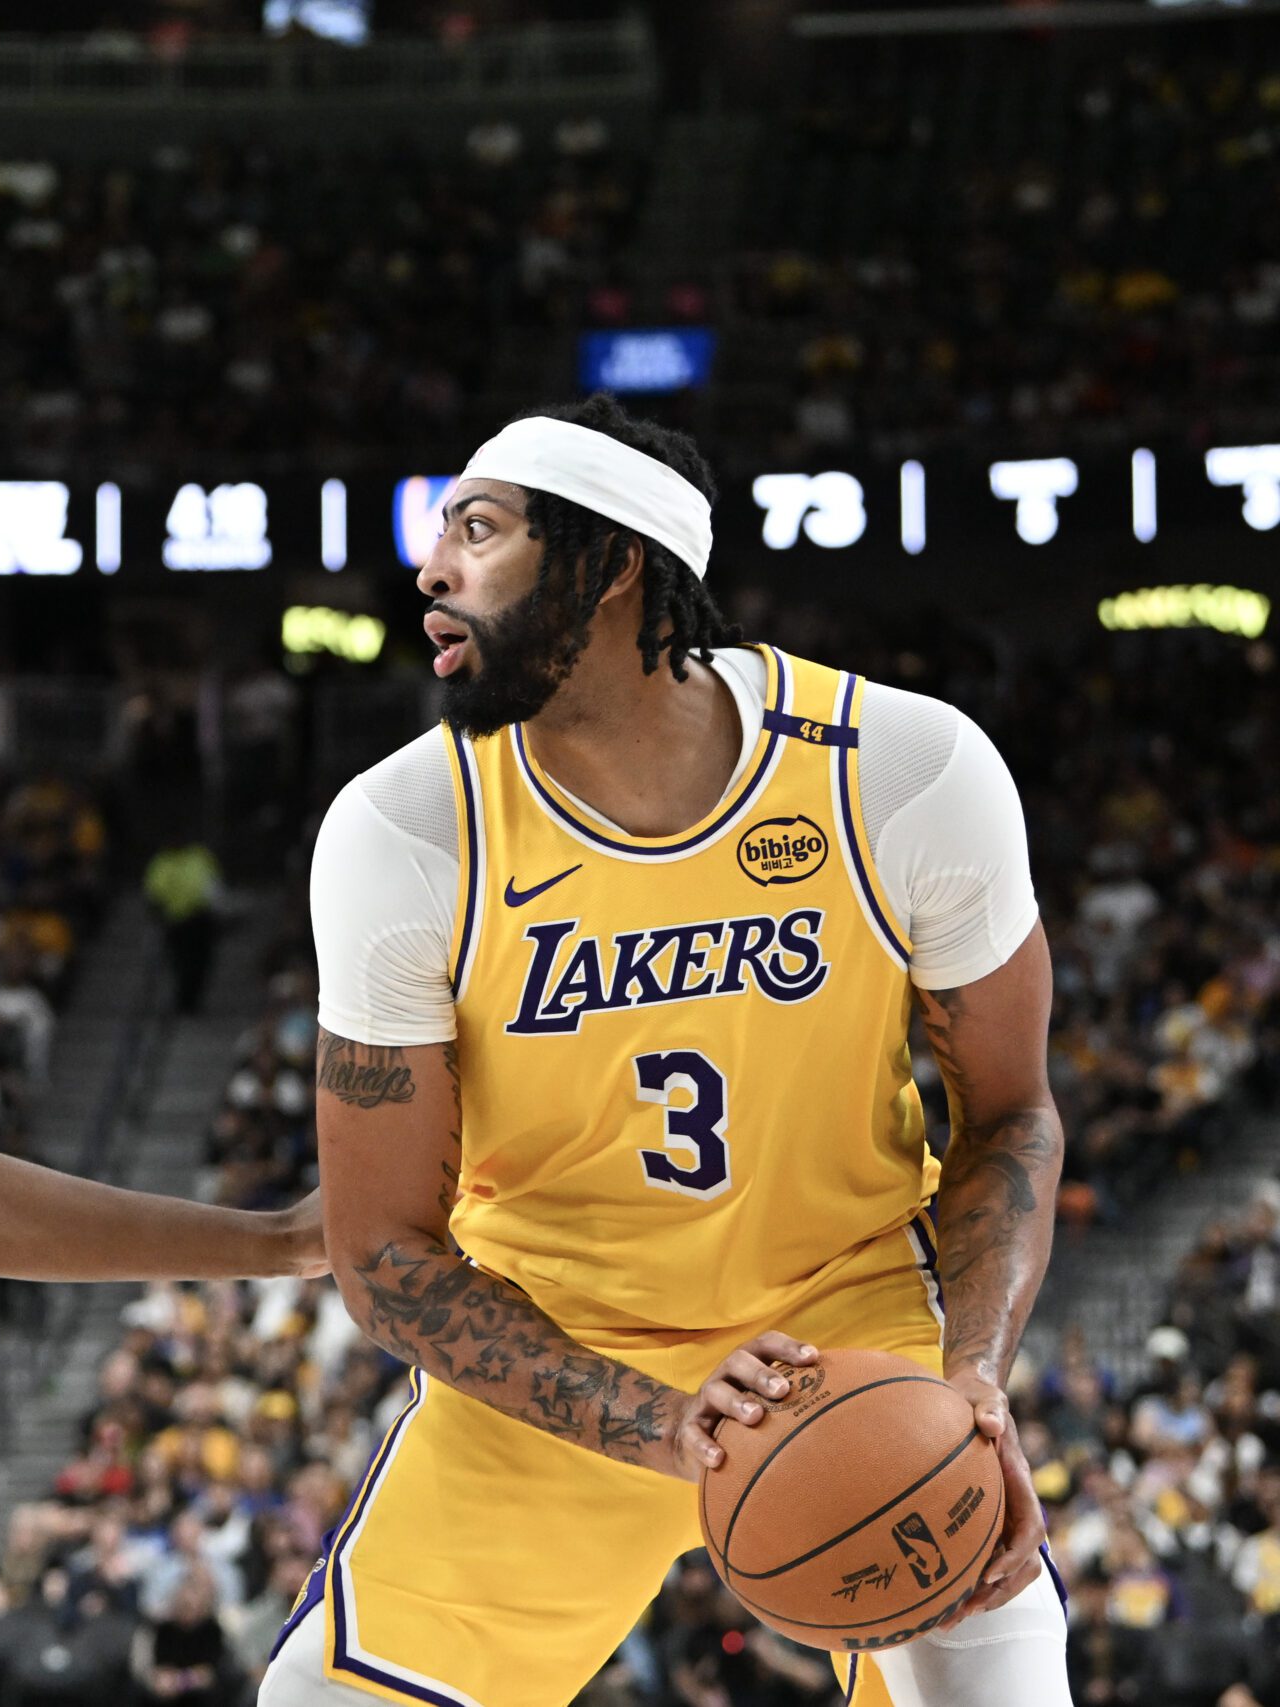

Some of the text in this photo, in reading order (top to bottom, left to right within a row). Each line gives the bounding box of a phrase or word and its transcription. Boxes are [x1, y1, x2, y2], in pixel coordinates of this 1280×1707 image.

[800, 721, 823, 742] 44
[744, 833, 823, 863] bibigo
[761, 858, 793, 872] 비비고
[504, 908, 831, 1036] LAKERS
[632, 1049, 732, 1201] 3
